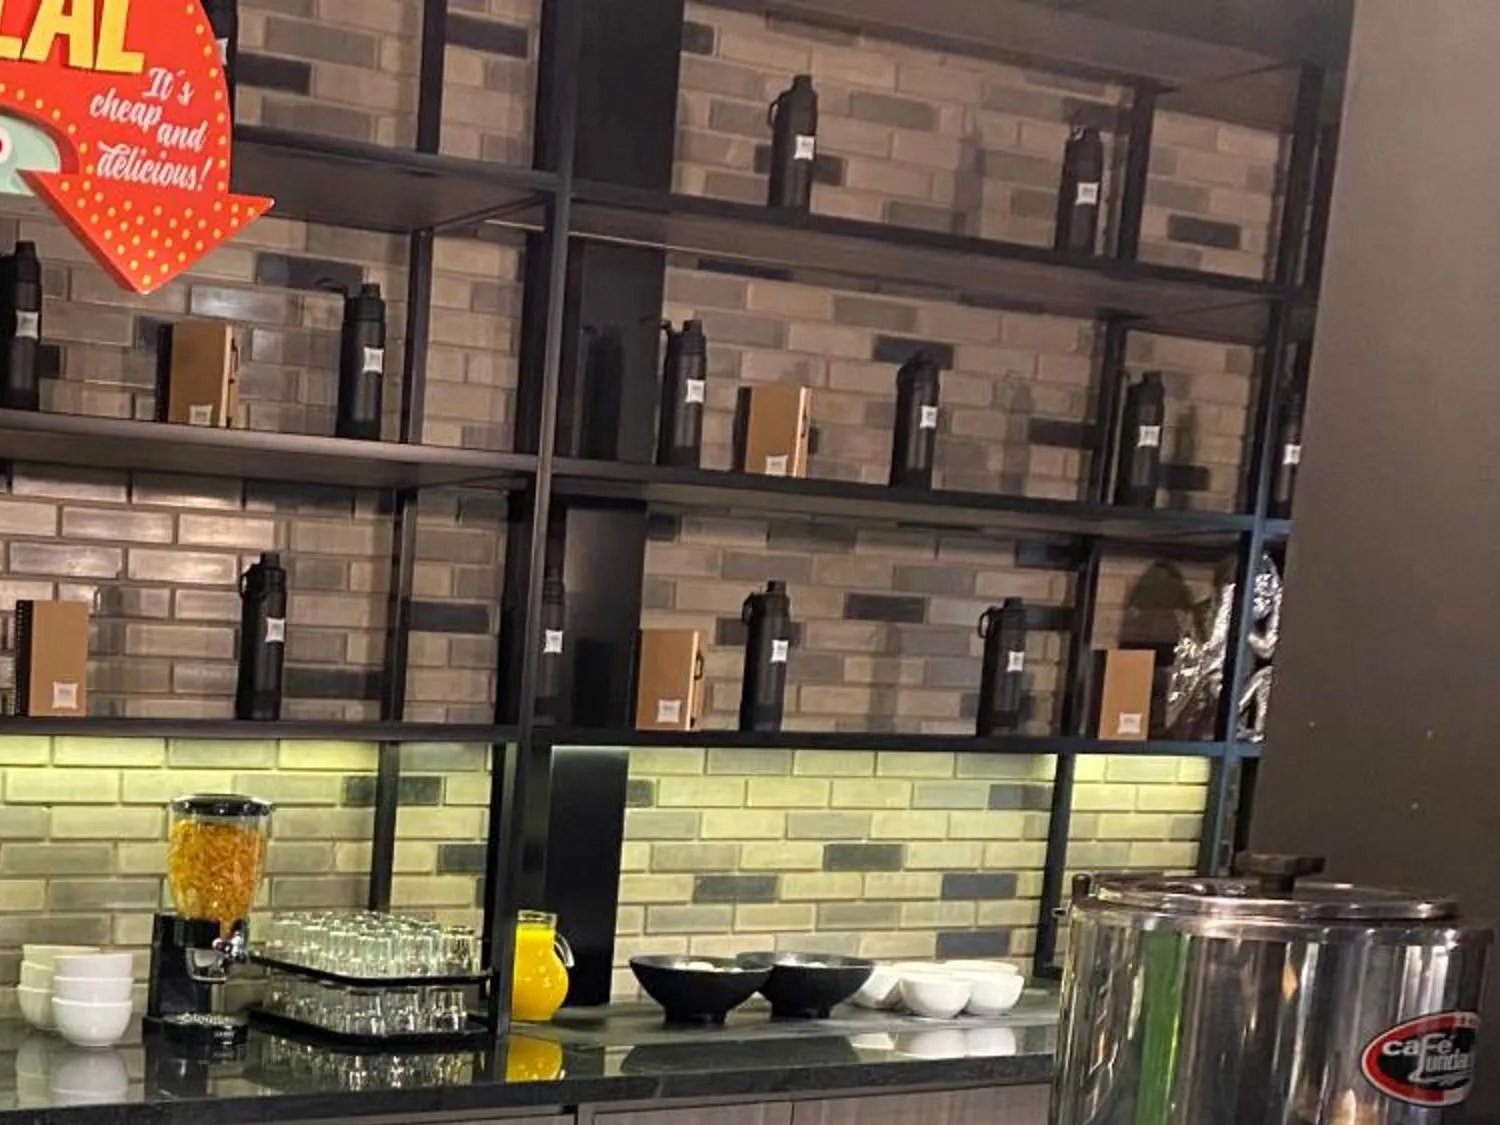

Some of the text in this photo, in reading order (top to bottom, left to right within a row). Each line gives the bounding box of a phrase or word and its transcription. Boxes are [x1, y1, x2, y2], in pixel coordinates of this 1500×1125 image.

[89, 87, 208, 152] cheap and
[96, 140, 213, 191] delicious!
